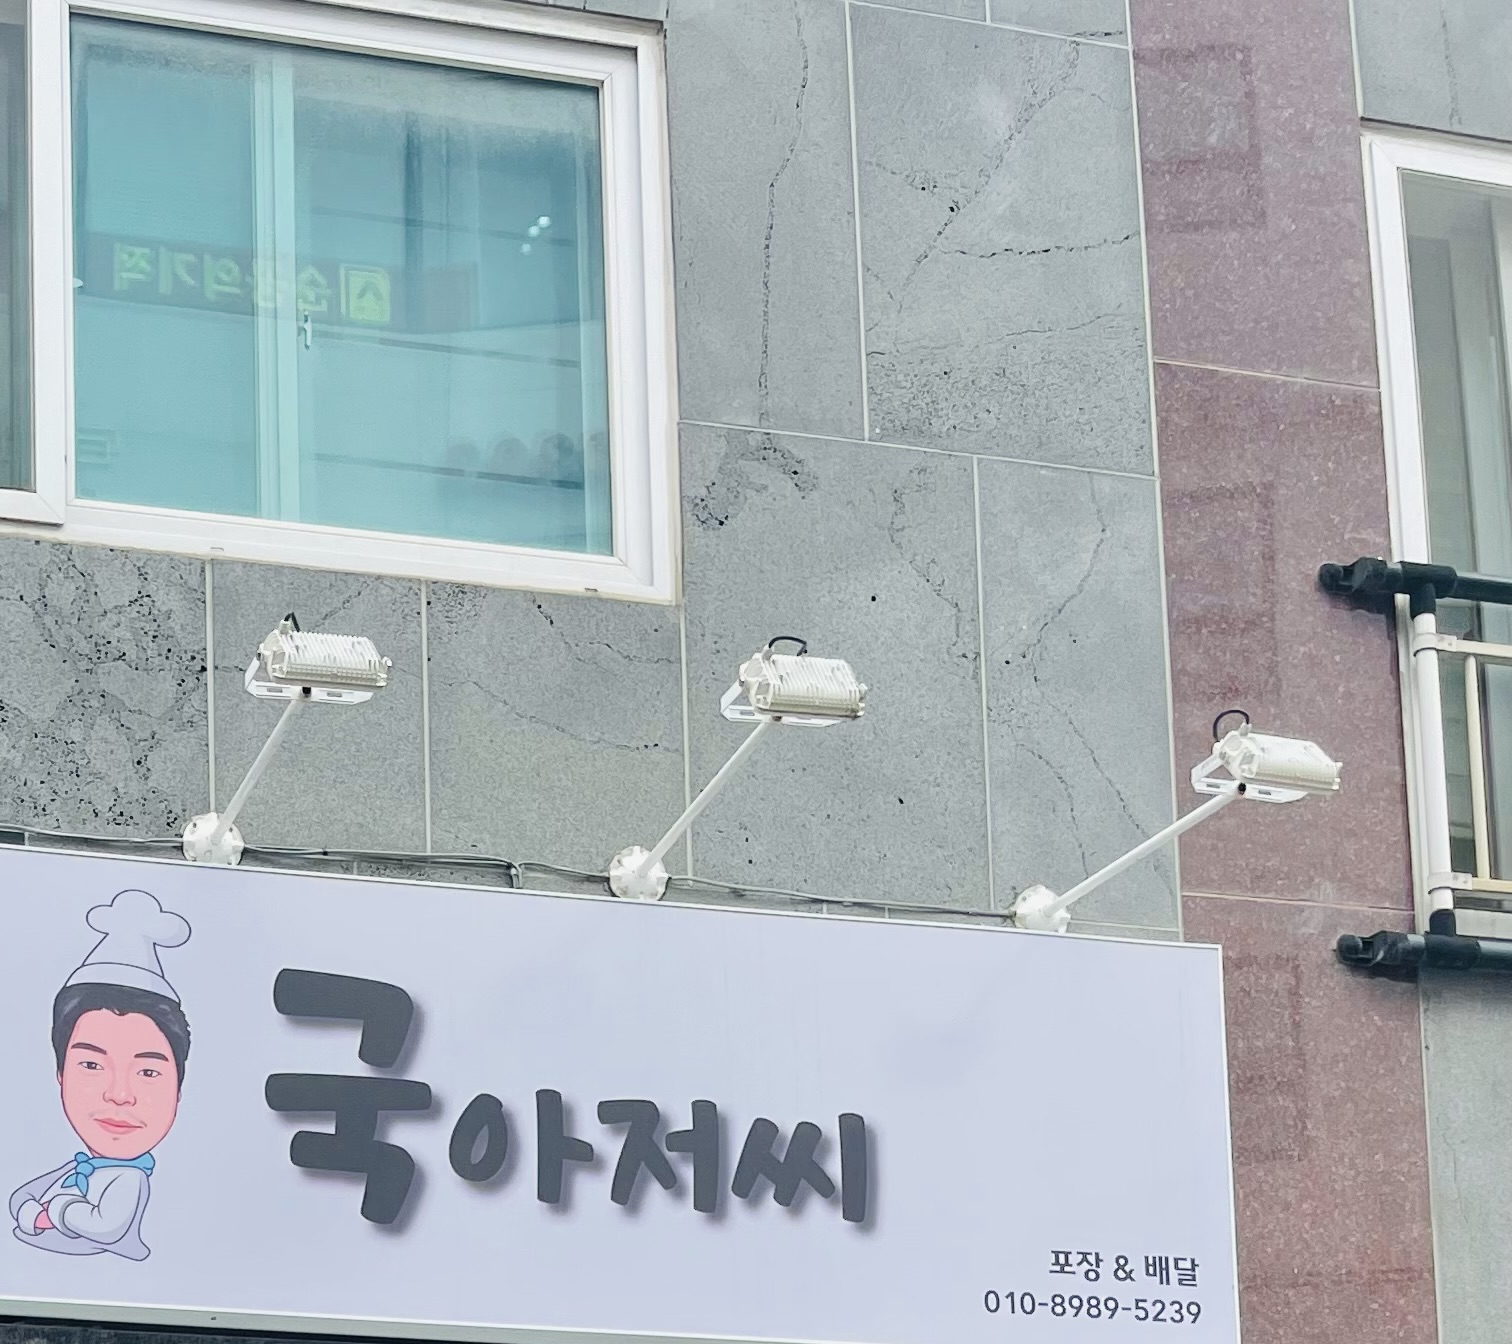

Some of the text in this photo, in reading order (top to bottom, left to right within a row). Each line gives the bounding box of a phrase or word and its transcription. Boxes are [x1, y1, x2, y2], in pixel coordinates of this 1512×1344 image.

[265, 968, 868, 1227] 국아저씨
[1049, 1250, 1200, 1287] 포장 & 배달
[984, 1290, 1202, 1324] 010-8989-5239
